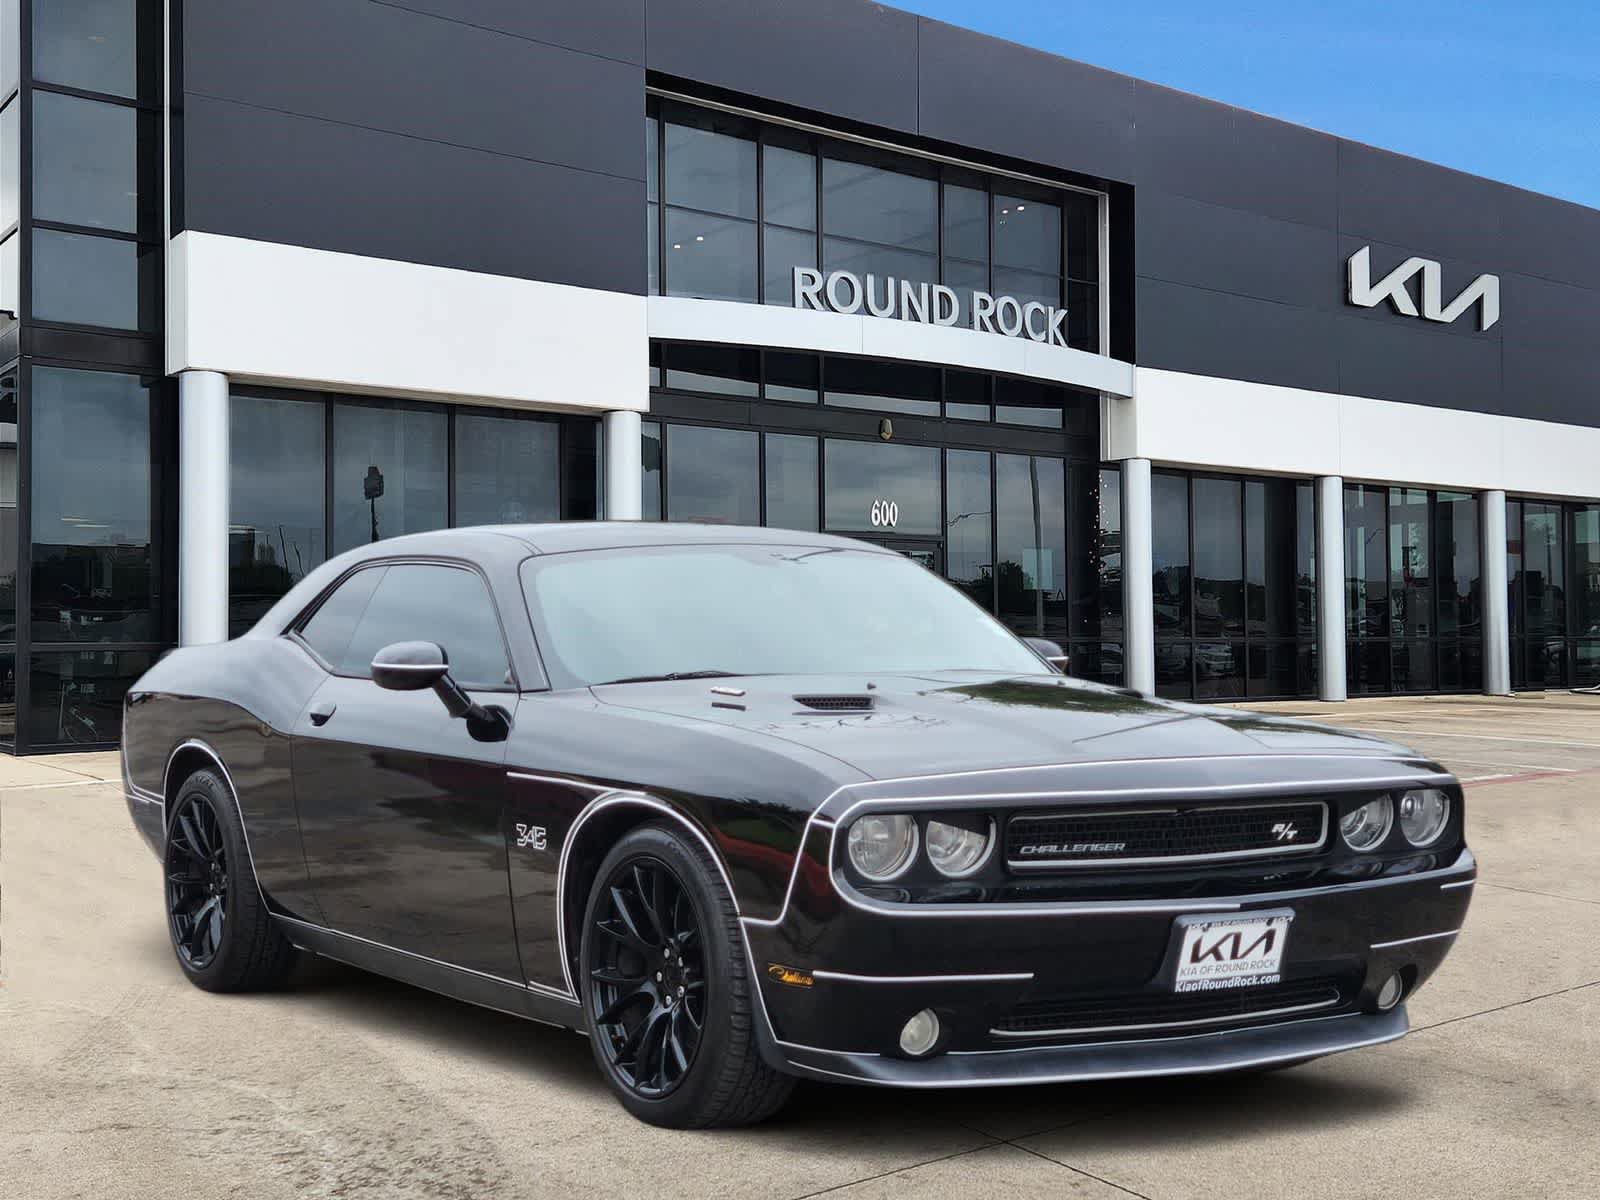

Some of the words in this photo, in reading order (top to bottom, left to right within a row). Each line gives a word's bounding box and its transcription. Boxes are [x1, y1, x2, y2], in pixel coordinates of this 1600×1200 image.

[1347, 245, 1500, 331] KIA
[793, 265, 960, 328] ROUND
[971, 290, 1069, 348] ROCK
[871, 499, 898, 528] 600
[1271, 821, 1298, 841] R/T
[1019, 842, 1126, 855] CHALLENGER
[1189, 928, 1277, 964] KIA
[1179, 966, 1198, 977] KIA
[1199, 964, 1214, 975] OF
[1214, 961, 1249, 974] ROUND
[1249, 958, 1277, 970] ROCK
[1174, 974, 1281, 993] KiaofRoundRock.com
